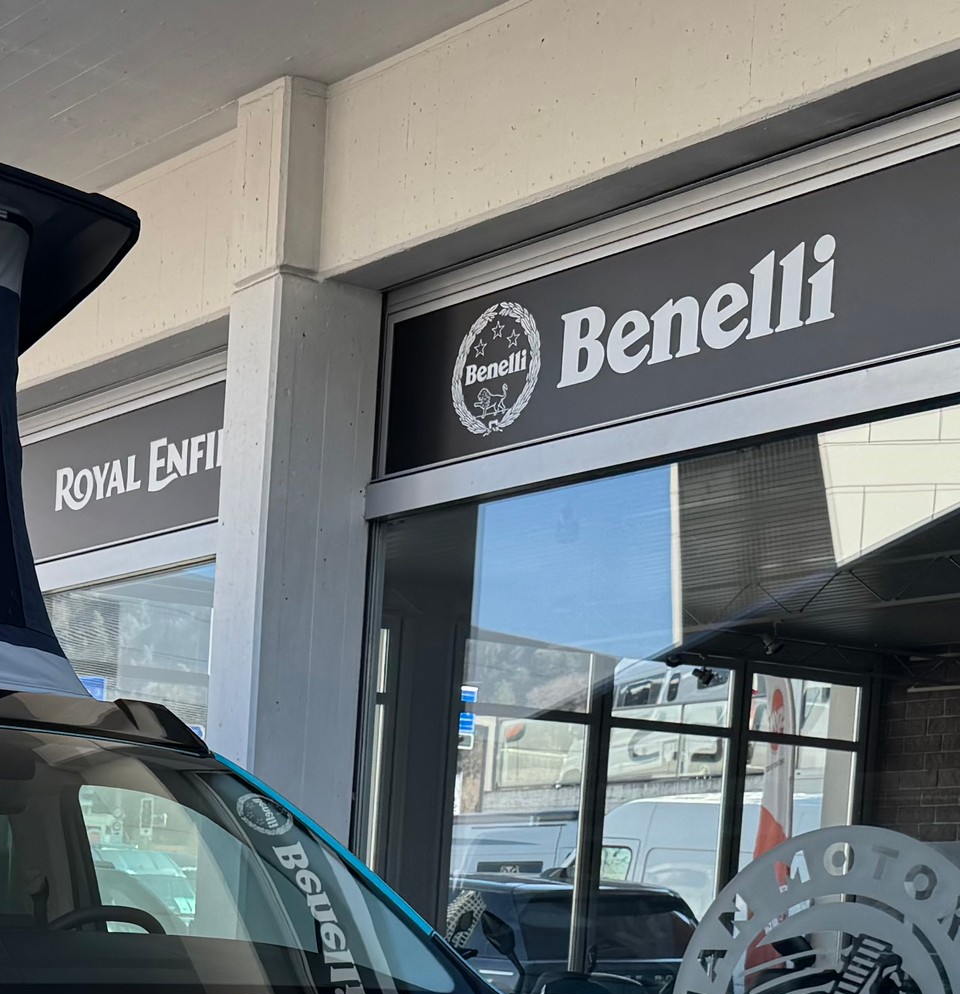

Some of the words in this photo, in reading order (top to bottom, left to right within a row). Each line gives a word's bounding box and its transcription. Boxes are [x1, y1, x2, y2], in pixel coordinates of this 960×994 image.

[556, 234, 837, 389] Benelli
[464, 349, 528, 386] Benelli
[54, 455, 142, 512] ROYAL
